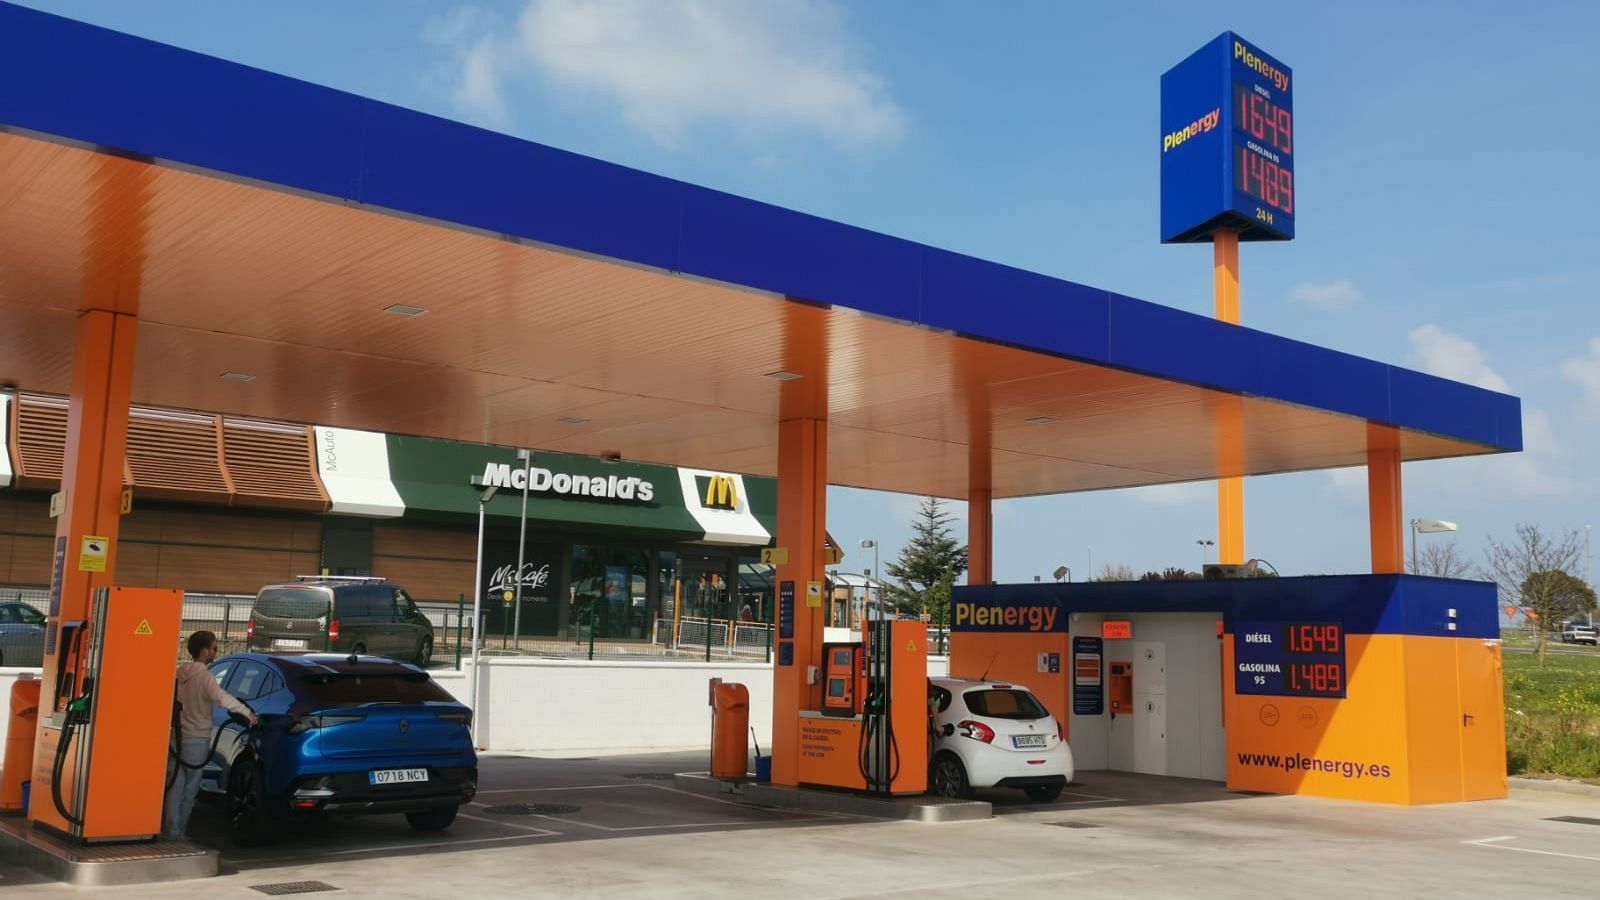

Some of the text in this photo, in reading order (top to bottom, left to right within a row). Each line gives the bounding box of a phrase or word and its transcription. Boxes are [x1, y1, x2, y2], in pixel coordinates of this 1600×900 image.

[1234, 41, 1289, 91] Plenergy
[1163, 107, 1220, 153] Plenergy
[1247, 140, 1273, 160] GASOLINA
[1256, 207, 1273, 225] 24 H
[325, 431, 336, 471] McAuto
[483, 463, 654, 501] McDonald's
[765, 551, 772, 563] 2
[956, 603, 1058, 631] Plenergy
[1245, 625, 1339, 653] DIÉSEL 1.649
[1239, 663, 1281, 673] GASOLINA
[1254, 664, 1341, 692] 95 1.489
[377, 770, 425, 782] 0718 NCY
[1238, 752, 1391, 778] www.plenergy.es
